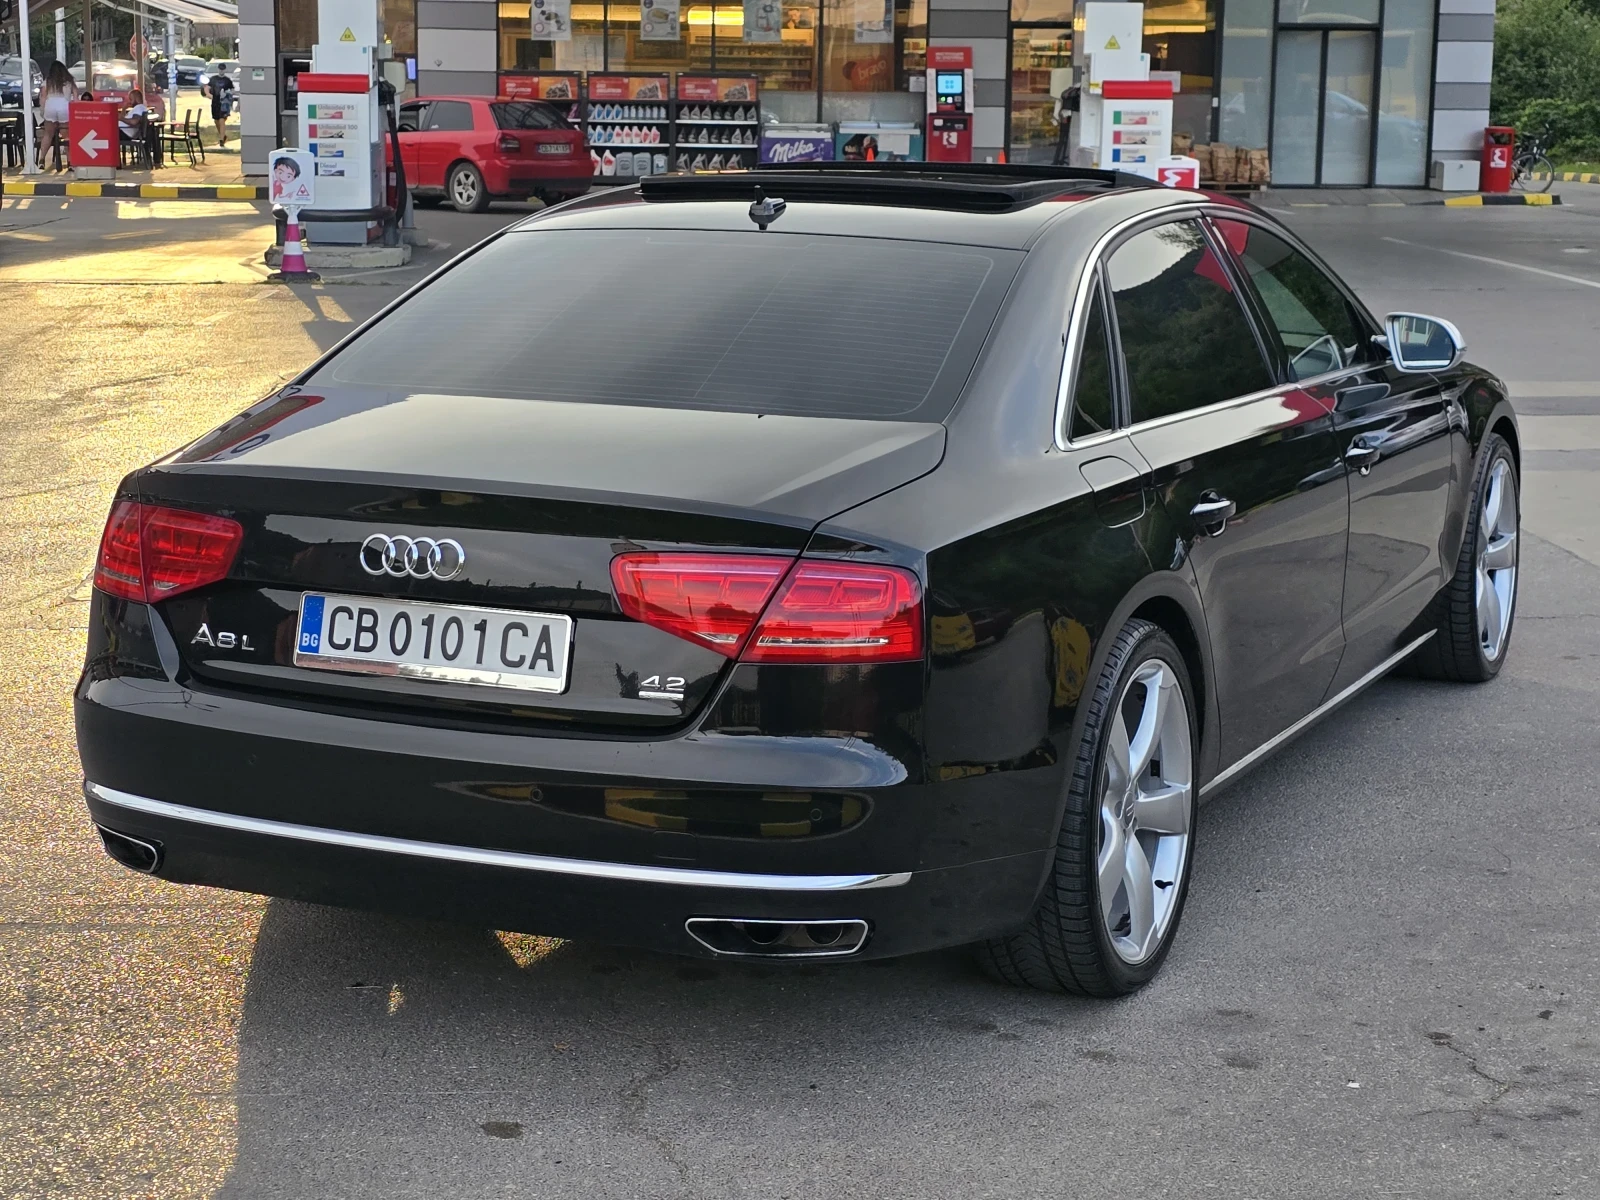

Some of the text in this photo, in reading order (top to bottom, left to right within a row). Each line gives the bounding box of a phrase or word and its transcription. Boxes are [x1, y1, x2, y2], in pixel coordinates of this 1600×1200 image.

[769, 140, 817, 163] Milka
[302, 632, 319, 647] BG
[328, 606, 554, 672] CB 0101 CA
[641, 675, 686, 691] 4.2
